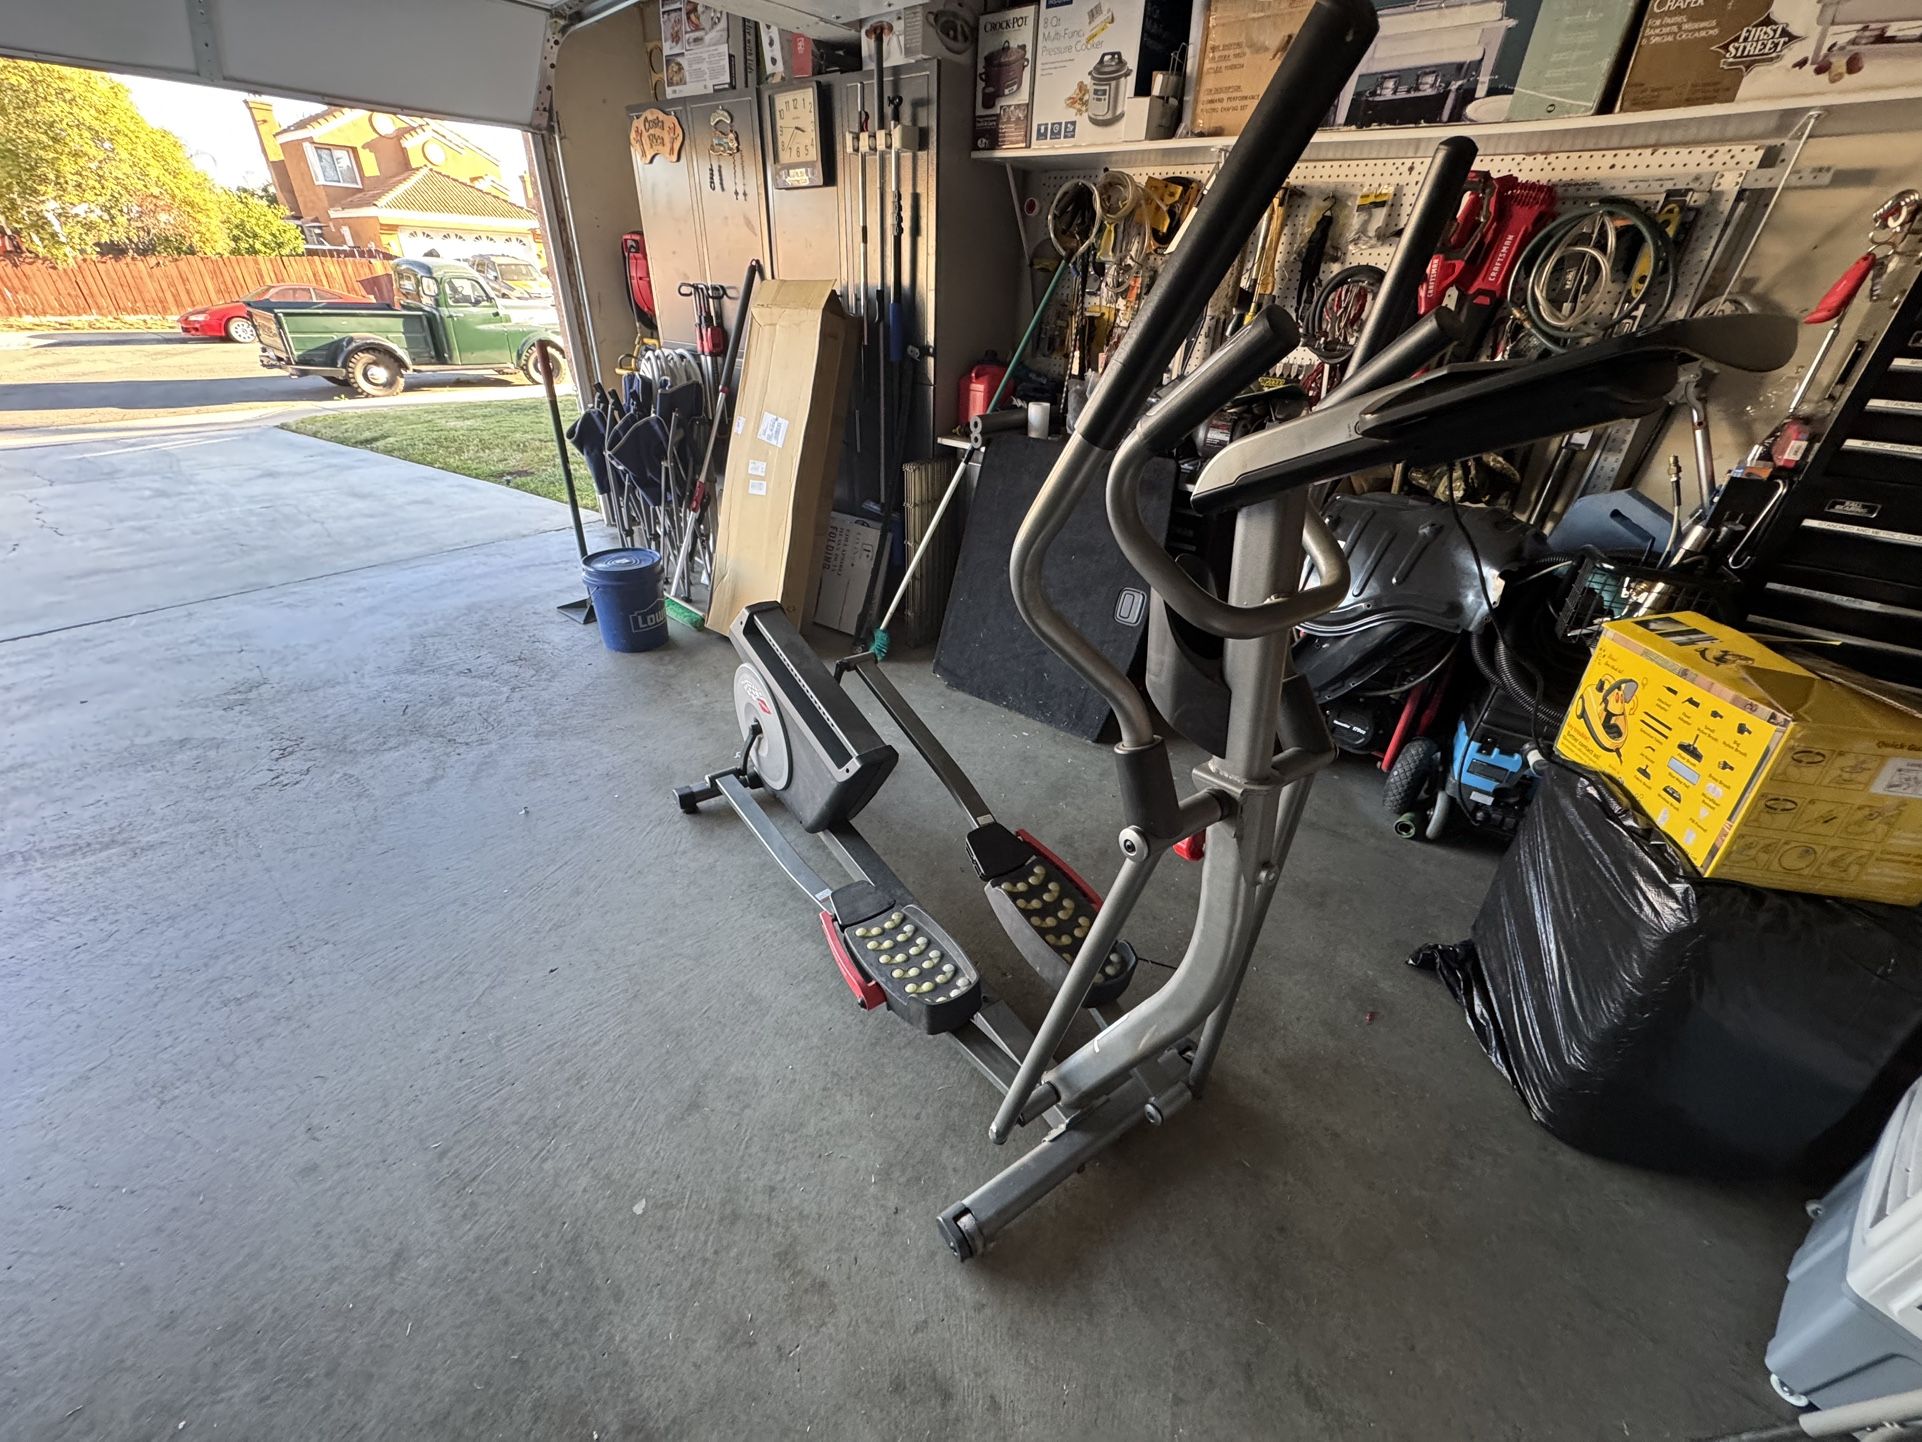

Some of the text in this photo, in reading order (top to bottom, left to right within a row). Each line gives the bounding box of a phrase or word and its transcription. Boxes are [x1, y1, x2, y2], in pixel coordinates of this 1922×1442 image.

[1043, 17, 1049, 29] 8
[1739, 24, 1787, 42] FIRST
[1726, 38, 1788, 58] STREET
[792, 98, 799, 110] 12
[802, 98, 806, 109] 1
[808, 102, 813, 113] 2
[778, 109, 785, 120] 10
[643, 116, 665, 132] Costa
[796, 147, 801, 158] 6
[804, 145, 809, 156] 5
[1489, 235, 1514, 281] CRAFTSMAN
[1427, 259, 1439, 297] CRAFTSMAN
